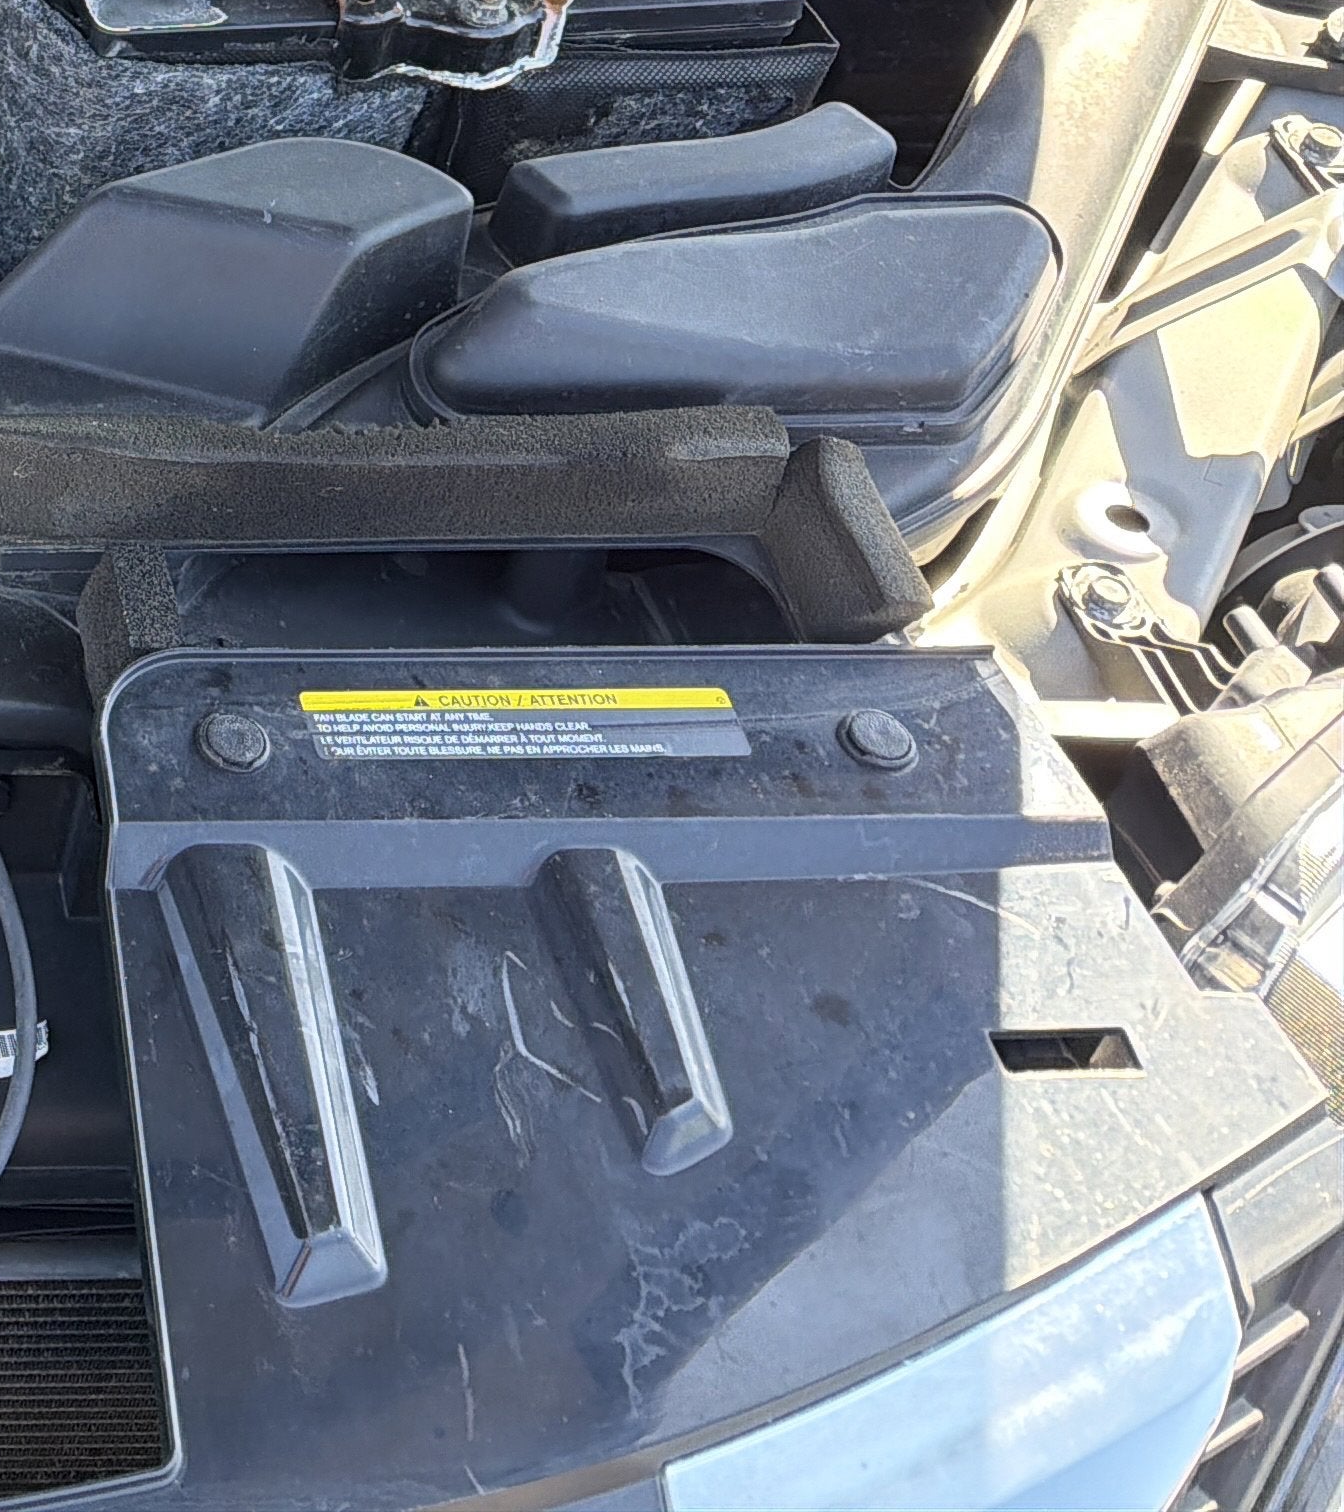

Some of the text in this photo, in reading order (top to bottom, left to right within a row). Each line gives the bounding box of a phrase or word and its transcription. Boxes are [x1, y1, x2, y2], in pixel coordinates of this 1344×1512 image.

[438, 695, 511, 707] CAUTION
[530, 693, 618, 706] ATTENTION
[313, 713, 334, 722] FAN
[335, 713, 370, 722] BLADE
[371, 713, 394, 722] CAN
[395, 713, 427, 722] START
[430, 713, 442, 721] AT
[445, 713, 464, 721] ANY
[316, 724, 332, 732] TO
[332, 724, 360, 732] HELP
[362, 724, 394, 732] AVOID
[395, 723, 451, 732] PERSONAL
[517, 722, 553, 731] HANDS
[335, 735, 402, 744] VENTILATEUR
[403, 735, 443, 745] RISQUE
[445, 735, 459, 744] DE
[461, 732, 520, 744] DÉMARRER
[529, 734, 557, 743] TOUT
[356, 744, 392, 755] ÉVITER
[392, 746, 427, 756] TOUTE
[487, 746, 503, 755] NE
[503, 745, 524, 754] PAS
[526, 744, 542, 754] EN
[542, 743, 608, 754] APPROCHER
[609, 743, 630, 753] LES
